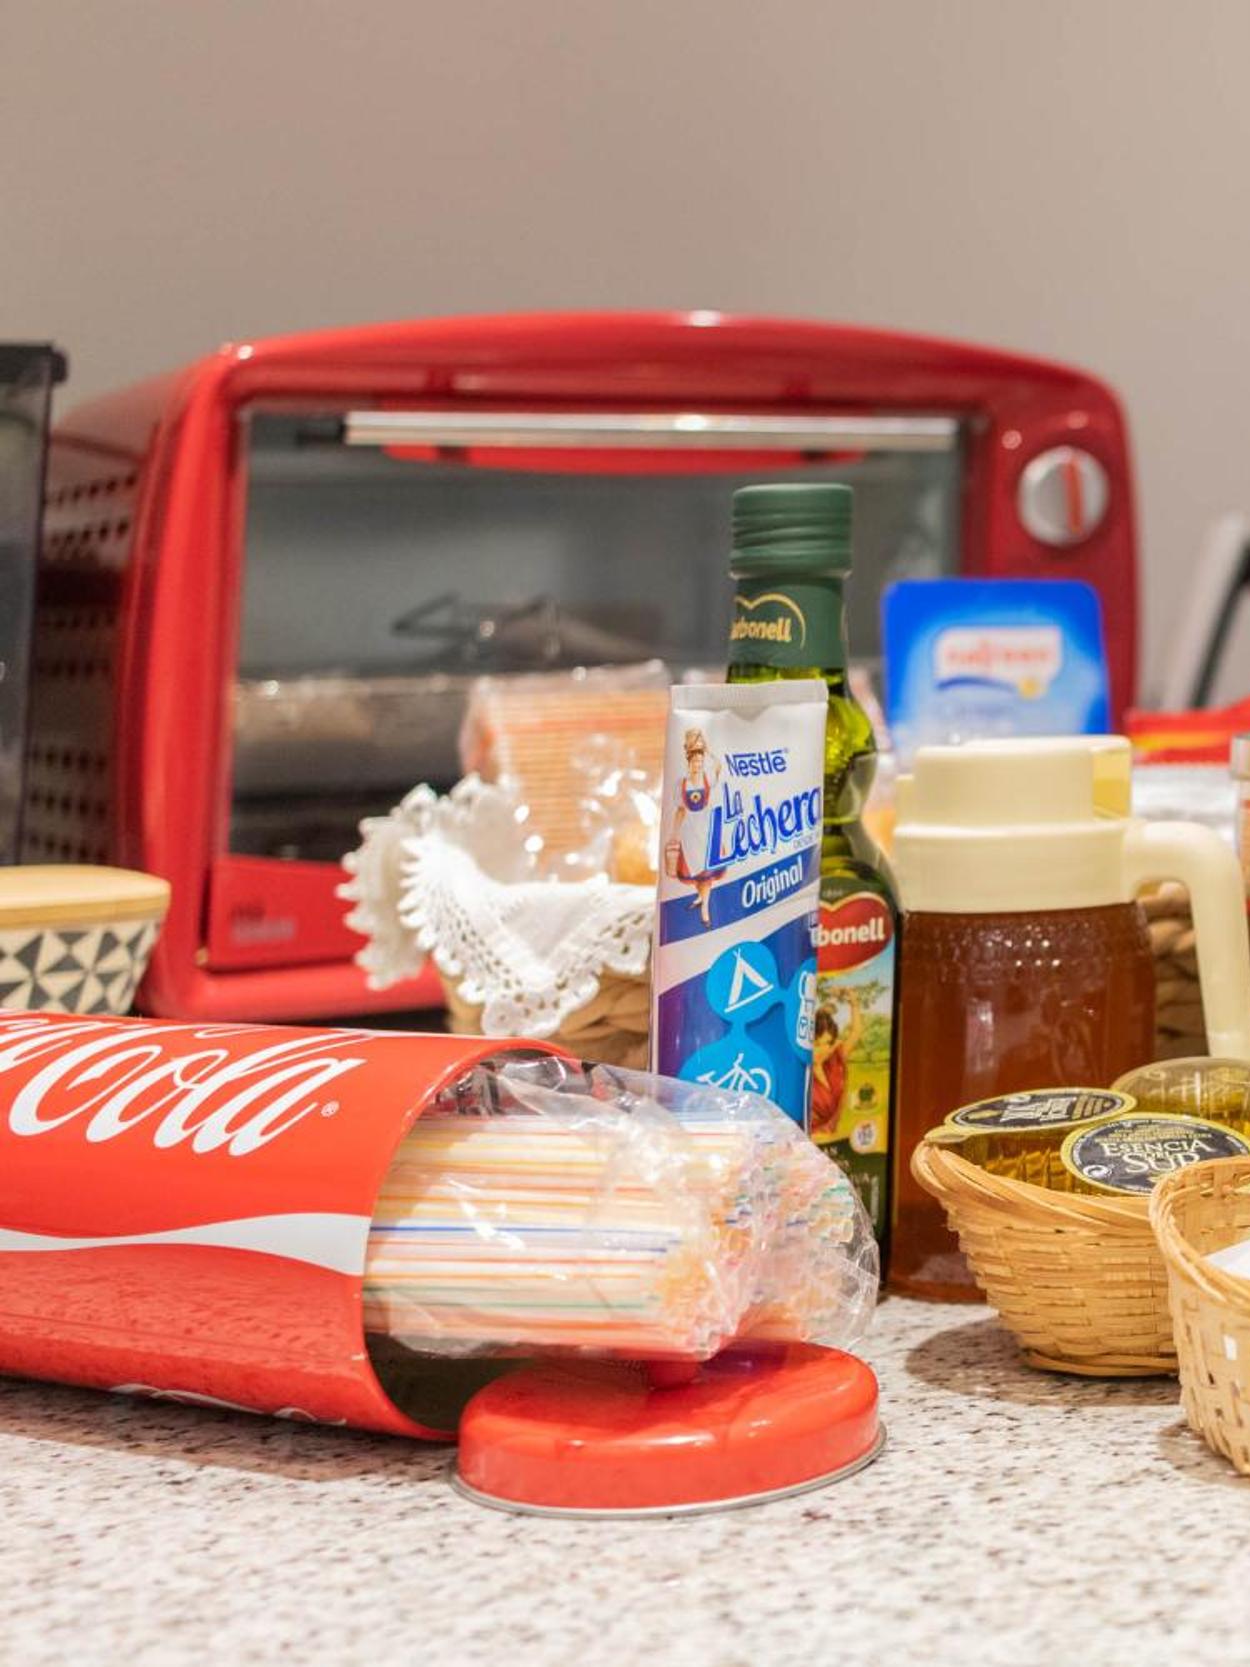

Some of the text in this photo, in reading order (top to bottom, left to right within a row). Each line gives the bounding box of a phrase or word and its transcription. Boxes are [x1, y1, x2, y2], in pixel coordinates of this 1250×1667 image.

[724, 782, 744, 821] La
[741, 855, 804, 909] Original
[1100, 1138, 1218, 1157] ESENCIA
